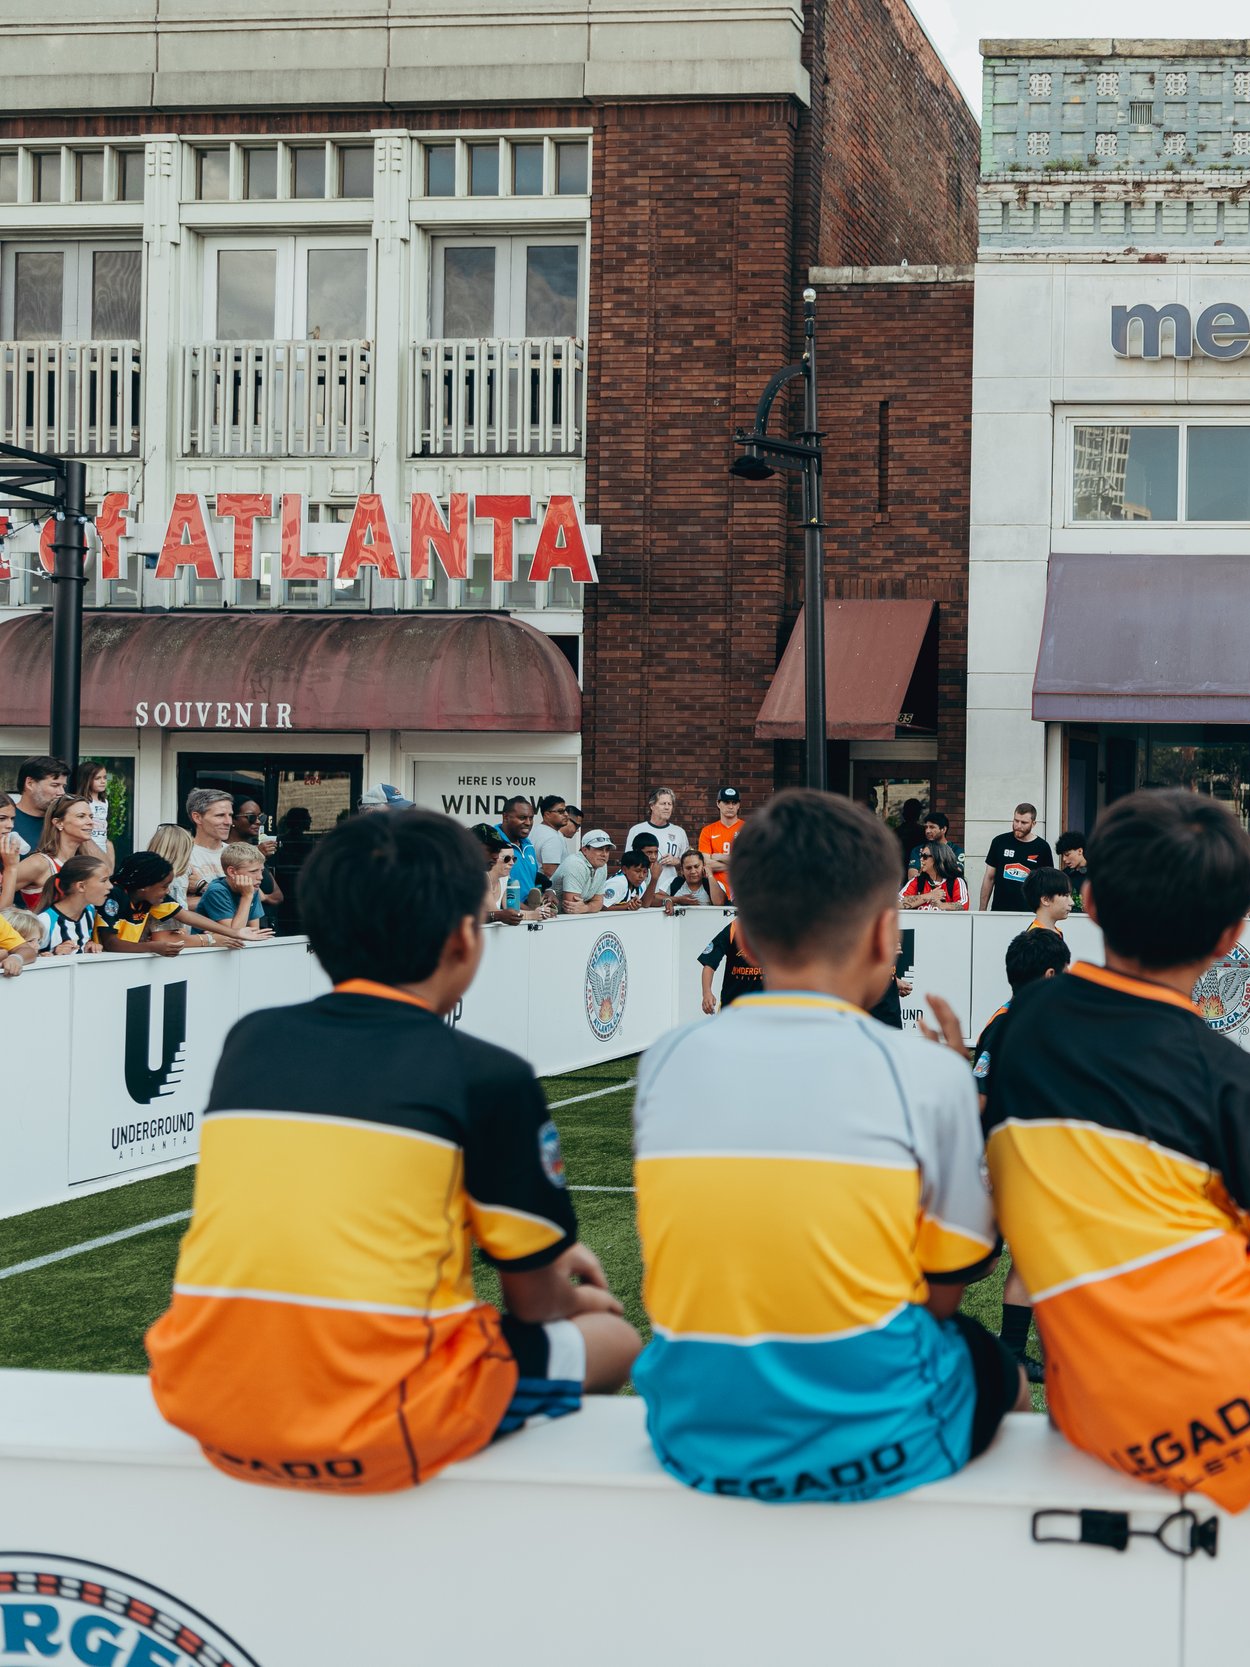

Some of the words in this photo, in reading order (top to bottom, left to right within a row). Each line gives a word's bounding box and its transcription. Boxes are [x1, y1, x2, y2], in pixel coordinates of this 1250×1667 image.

[155, 491, 600, 584] ATLANTA
[135, 701, 293, 729] SOUVENIR
[458, 776, 488, 786] HERE
[491, 776, 503, 786] IS
[506, 776, 537, 787] YOUR
[441, 794, 544, 816] WINDW
[666, 841, 678, 857] 10
[722, 841, 731, 855] 9
[111, 1111, 195, 1150] UNDERGROUND
[118, 1136, 187, 1161] ATLANTA
